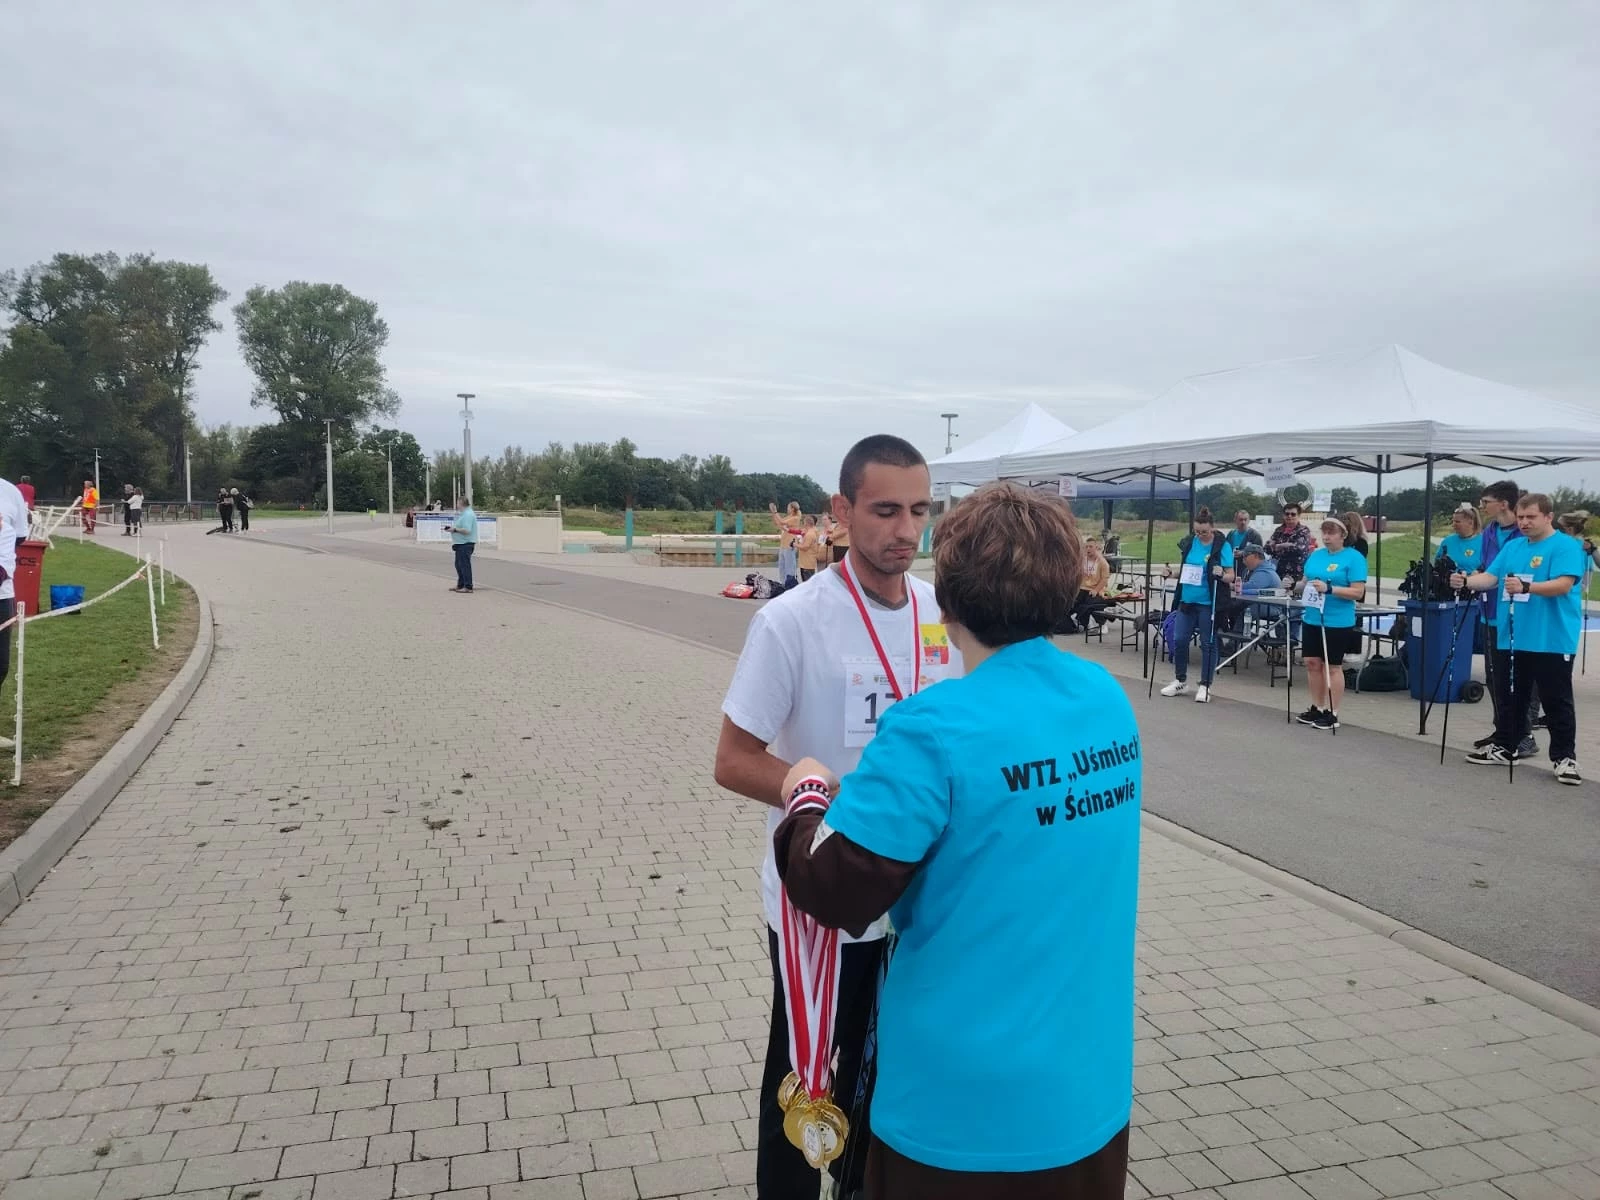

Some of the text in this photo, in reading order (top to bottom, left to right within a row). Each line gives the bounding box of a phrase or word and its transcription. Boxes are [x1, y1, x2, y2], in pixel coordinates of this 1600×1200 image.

[1000, 758, 1061, 792] WTZ
[1036, 777, 1135, 826] w Ścinawie
